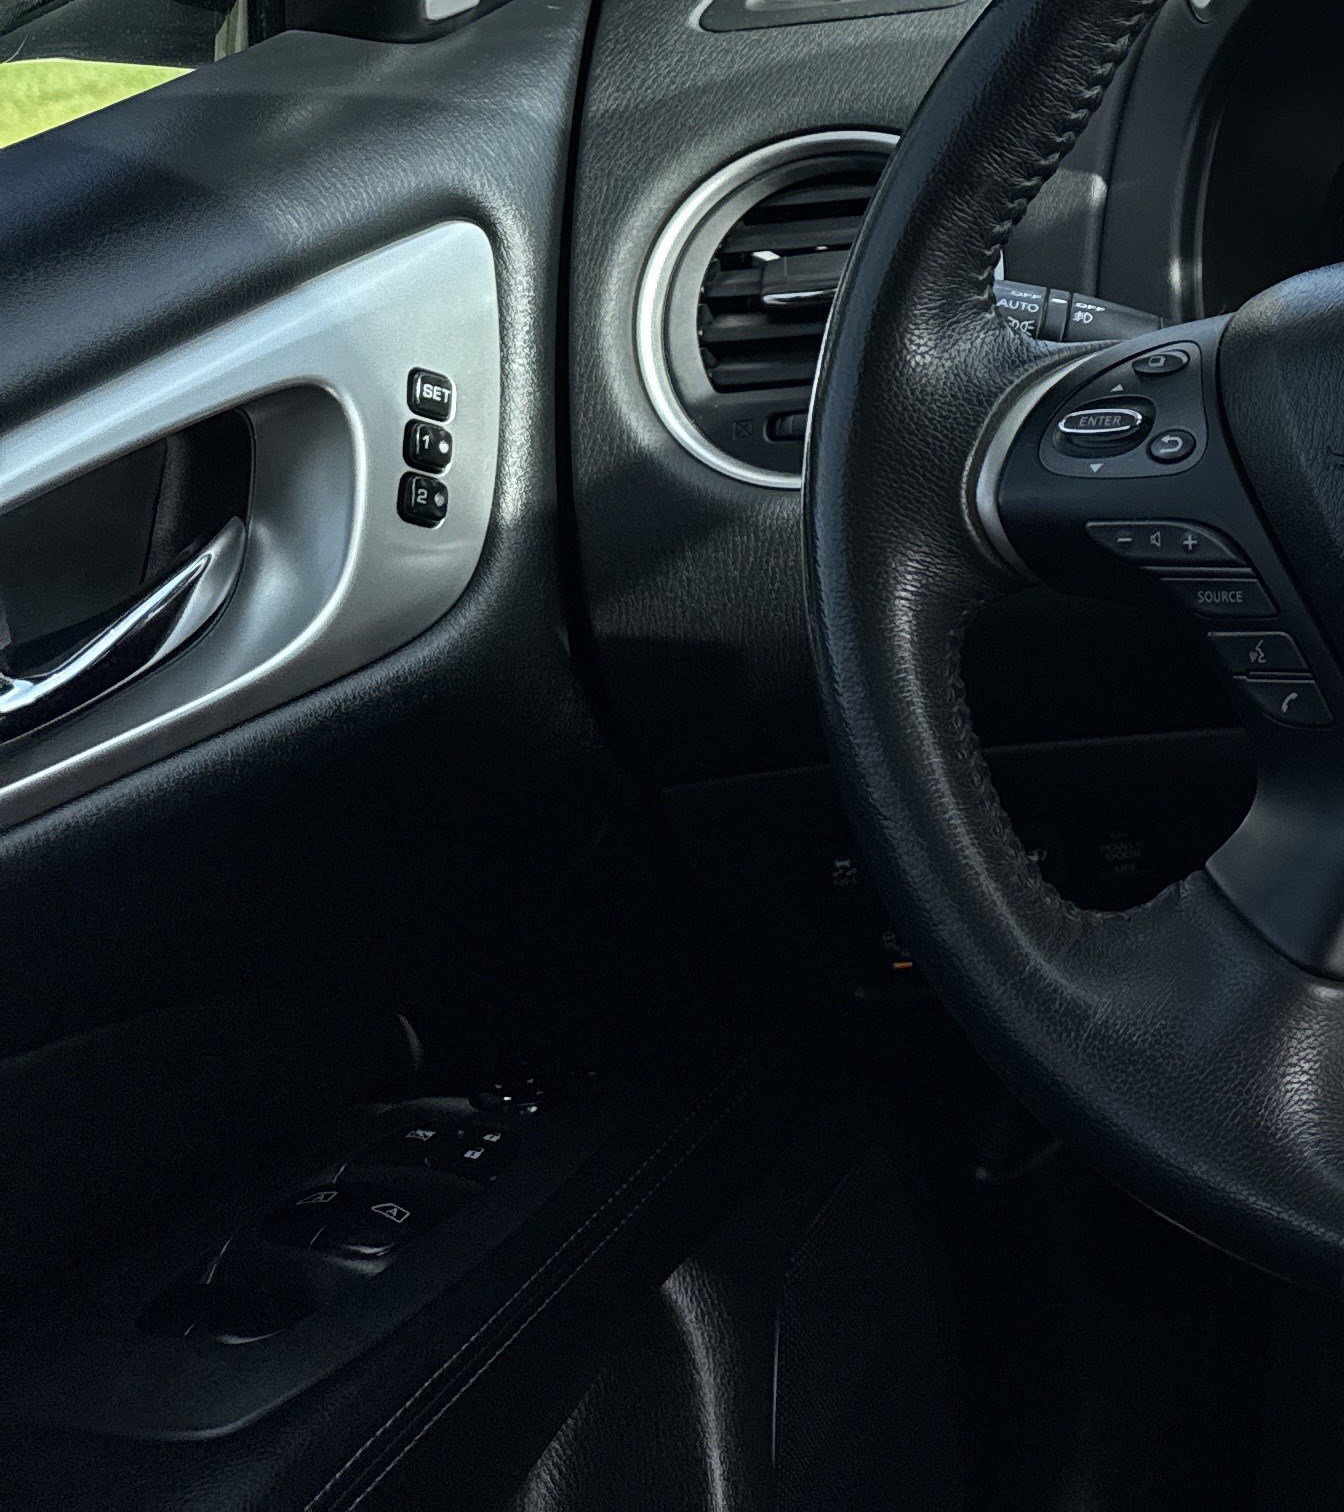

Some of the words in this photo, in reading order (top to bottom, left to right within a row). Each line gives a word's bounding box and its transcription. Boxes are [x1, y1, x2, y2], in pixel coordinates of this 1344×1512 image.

[995, 297, 1041, 314] AUTO
[422, 383, 452, 404] SET
[1078, 413, 1123, 428] ENTER
[421, 434, 431, 450] 1
[416, 488, 428, 505] 2
[1196, 589, 1244, 605] SOURCE
